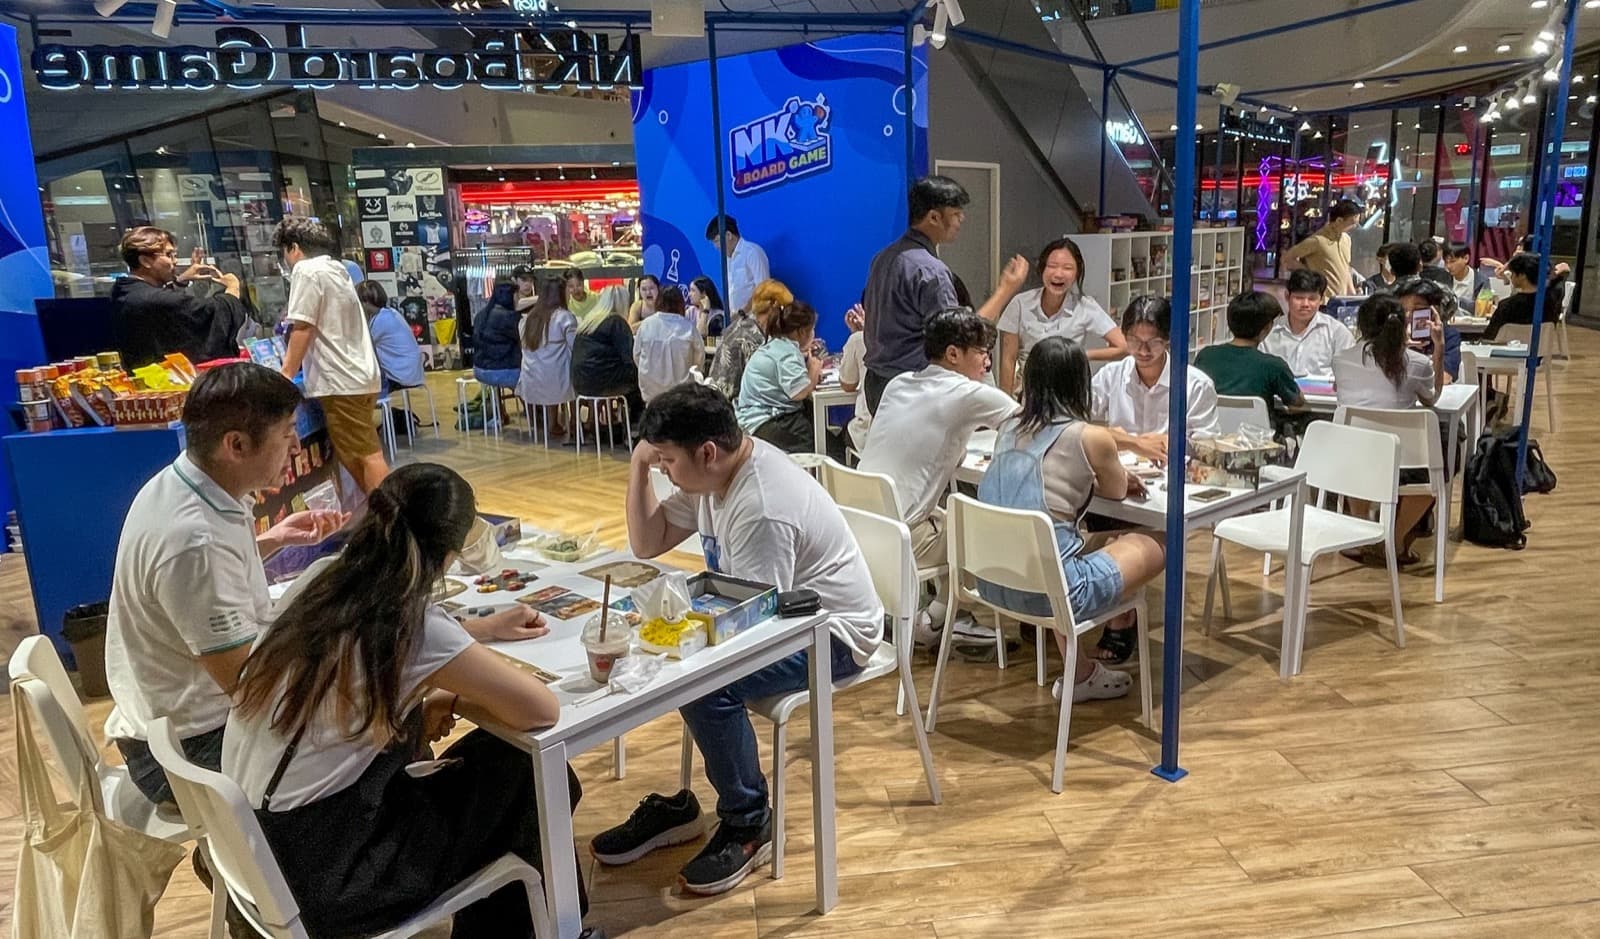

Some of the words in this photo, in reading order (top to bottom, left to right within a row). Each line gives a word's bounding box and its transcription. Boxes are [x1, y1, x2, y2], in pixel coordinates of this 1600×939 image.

[735, 112, 793, 170] NK
[743, 161, 786, 183] BOARD
[789, 147, 826, 169] GAME
